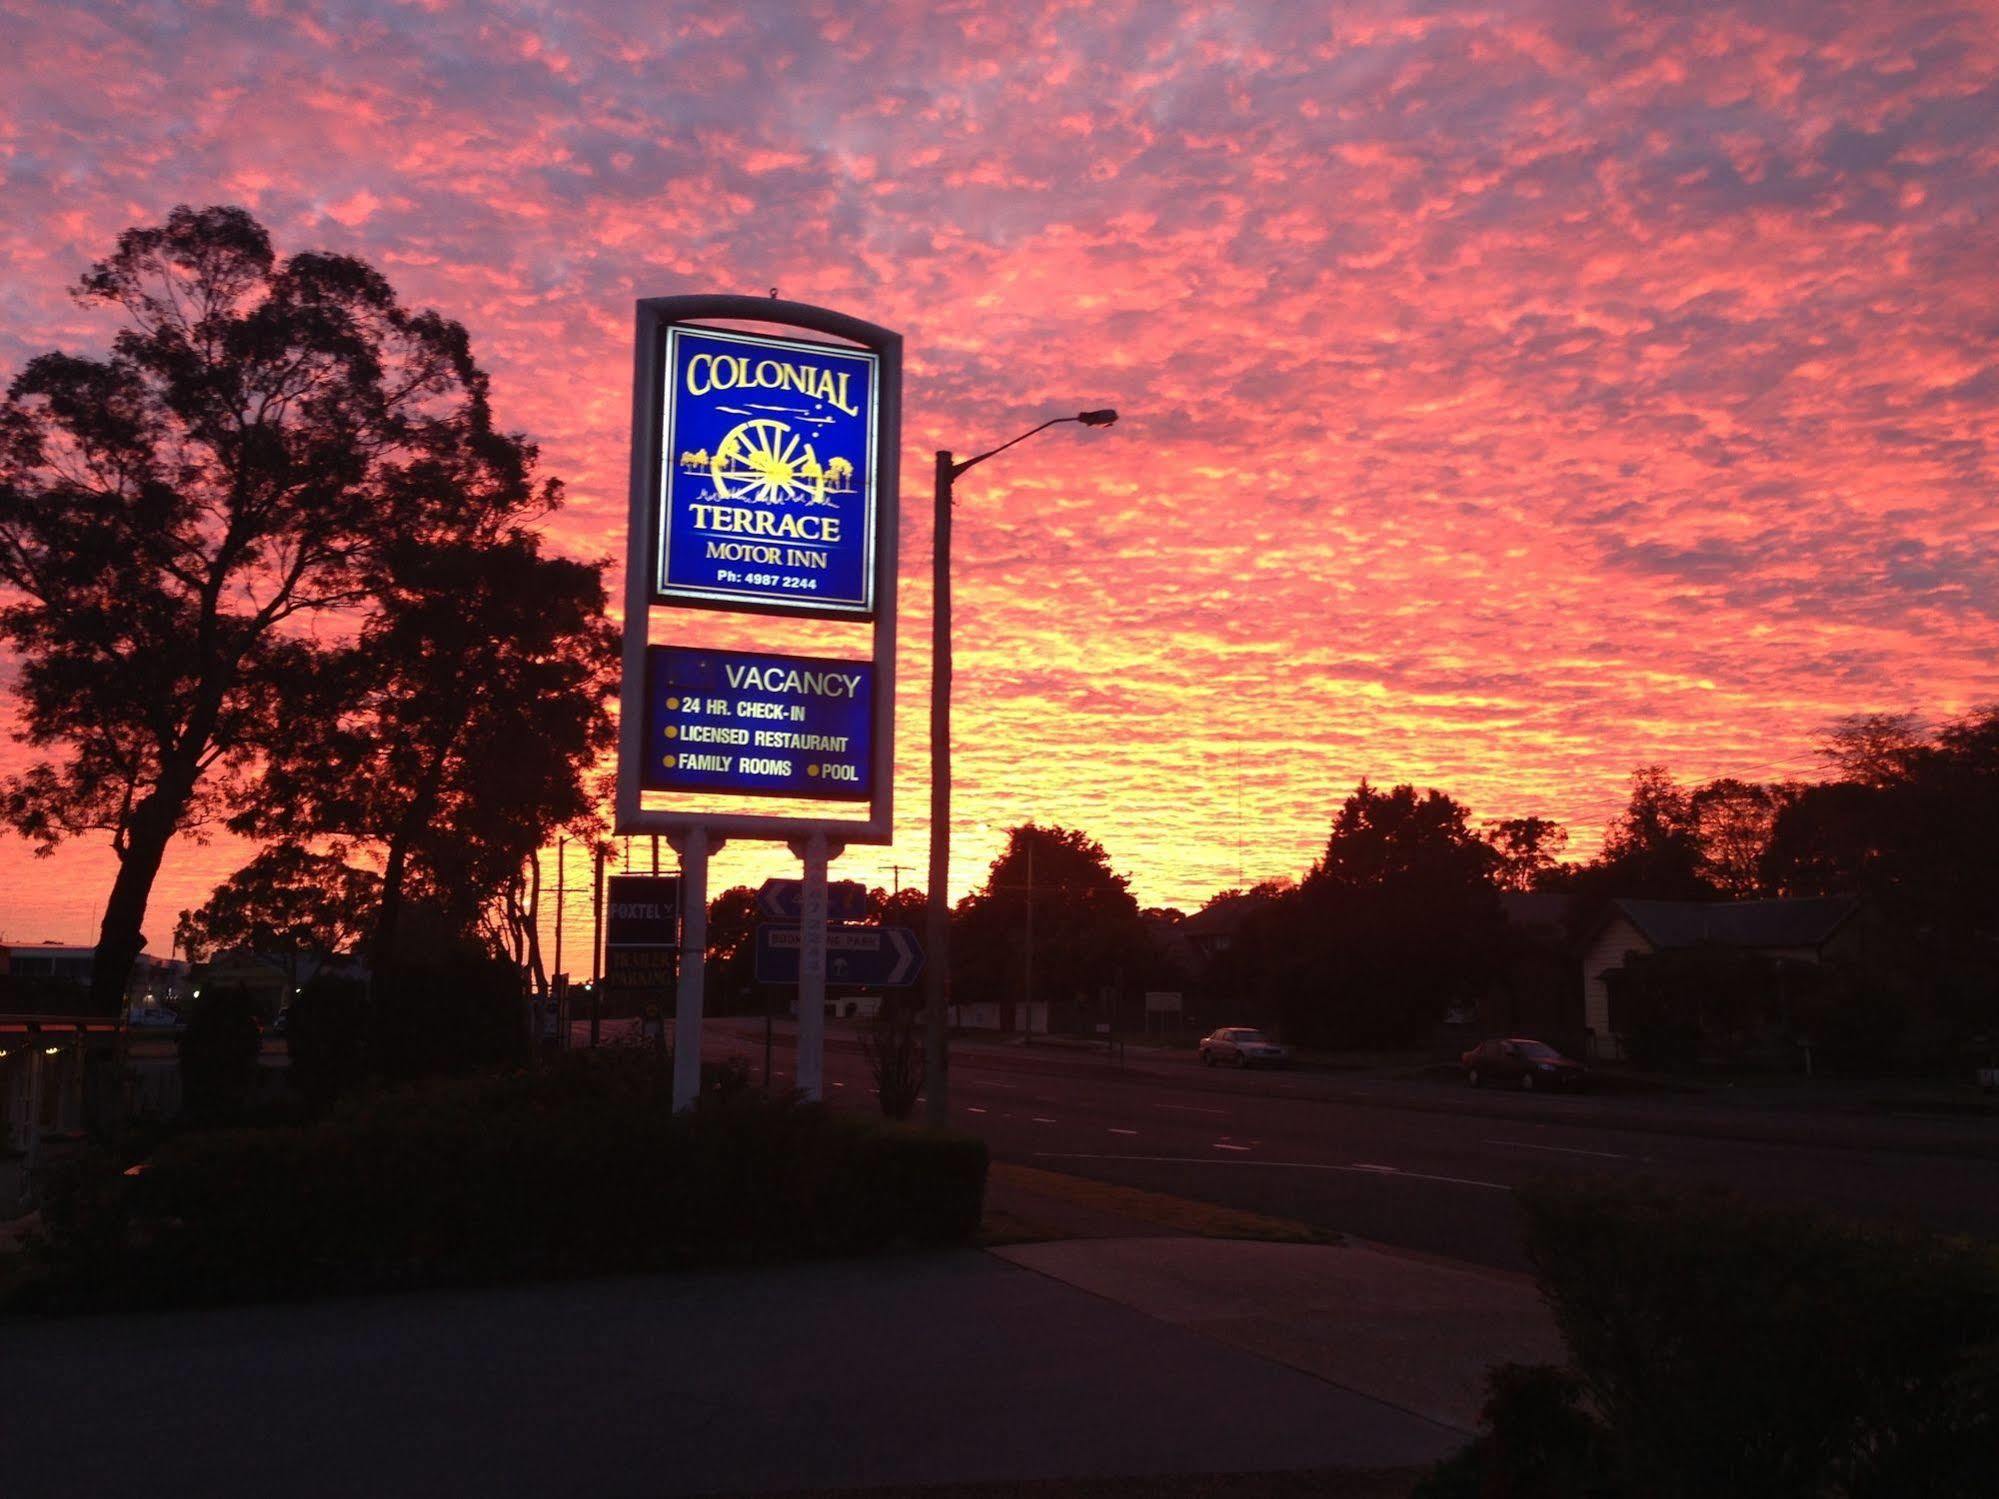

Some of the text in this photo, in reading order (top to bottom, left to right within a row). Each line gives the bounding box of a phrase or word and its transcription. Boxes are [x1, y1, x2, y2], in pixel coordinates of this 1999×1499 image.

[686, 354, 858, 417] COLONIAL
[688, 504, 841, 542] TERRACE
[706, 542, 828, 570] MOTOR INN
[717, 569, 817, 590] Ph: 4987 2244
[725, 664, 861, 698] VACANCY
[681, 697, 805, 722] 24 HR. CHECK-IN
[680, 726, 849, 753] LICENSED RESTAURANT
[678, 753, 793, 777] FAMILY ROOMS
[821, 764, 860, 782] POOL
[609, 903, 662, 920] FOXTEL
